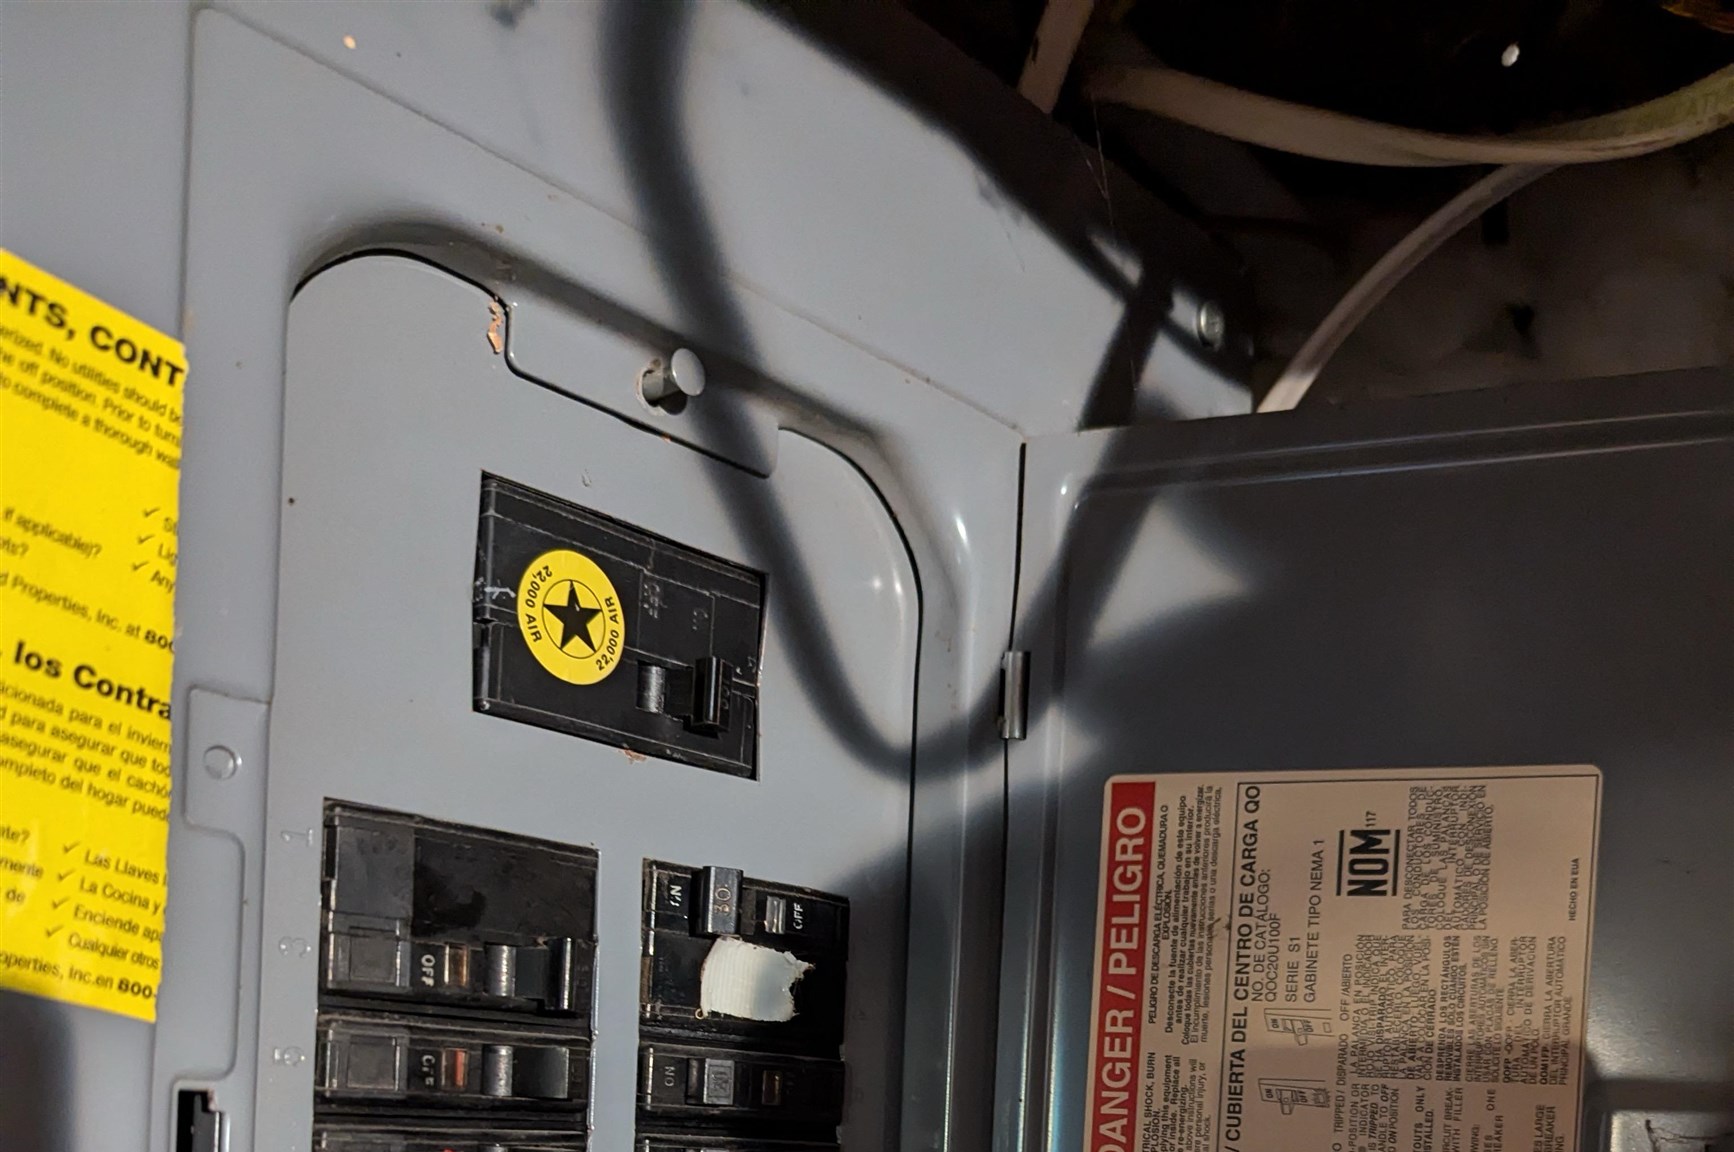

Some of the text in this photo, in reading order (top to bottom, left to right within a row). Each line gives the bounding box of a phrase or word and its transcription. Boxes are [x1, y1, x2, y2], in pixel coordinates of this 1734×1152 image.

[90, 325, 184, 387] CONT
[102, 397, 134, 423] Prior
[123, 386, 167, 416] should
[12, 382, 153, 455] complete thorough
[524, 565, 553, 644] 22,000 AIR
[595, 596, 620, 671] 22,000 AIR
[14, 640, 171, 720] los Contra
[68, 708, 103, 729] para
[10, 711, 147, 769] para asegurar que
[73, 756, 101, 775] que
[60, 775, 129, 807] del hogar
[1243, 786, 1259, 814] QO
[281, 828, 314, 846] 1
[1239, 819, 1258, 887] CARGA
[1346, 811, 1391, 896] NOM 117
[84, 848, 160, 883] Las Llaves
[1309, 850, 1323, 891] NEMA
[79, 876, 150, 909] La Cocina
[1107, 807, 1146, 976] PELIGRO
[1237, 894, 1254, 917] DE
[1568, 859, 1579, 921] HECHO EN EUA
[73, 903, 140, 935] Enciende
[1307, 895, 1321, 927] TIPO
[68, 932, 159, 970] Cualquier otros
[278, 935, 312, 957] 3
[1233, 924, 1252, 1001] CENTRO
[1265, 913, 1280, 1003] QOC20U100F
[420, 955, 435, 986] OFF
[1252, 955, 1265, 974] DE
[1285, 937, 1300, 1003] SERIE S1
[1304, 932, 1319, 1004] GABINETE
[1106, 985, 1135, 1000] /
[1251, 978, 1264, 1003] NO.
[1230, 1007, 1247, 1043] DEL
[274, 1046, 306, 1066] 5
[1145, 1053, 1156, 1079] BURN
[665, 1066, 675, 1087] ON
[1143, 1082, 1154, 1118] SHOCK,
[1225, 1049, 1245, 1142] CUBIERTA
[1414, 1086, 1425, 1113] ONLY
